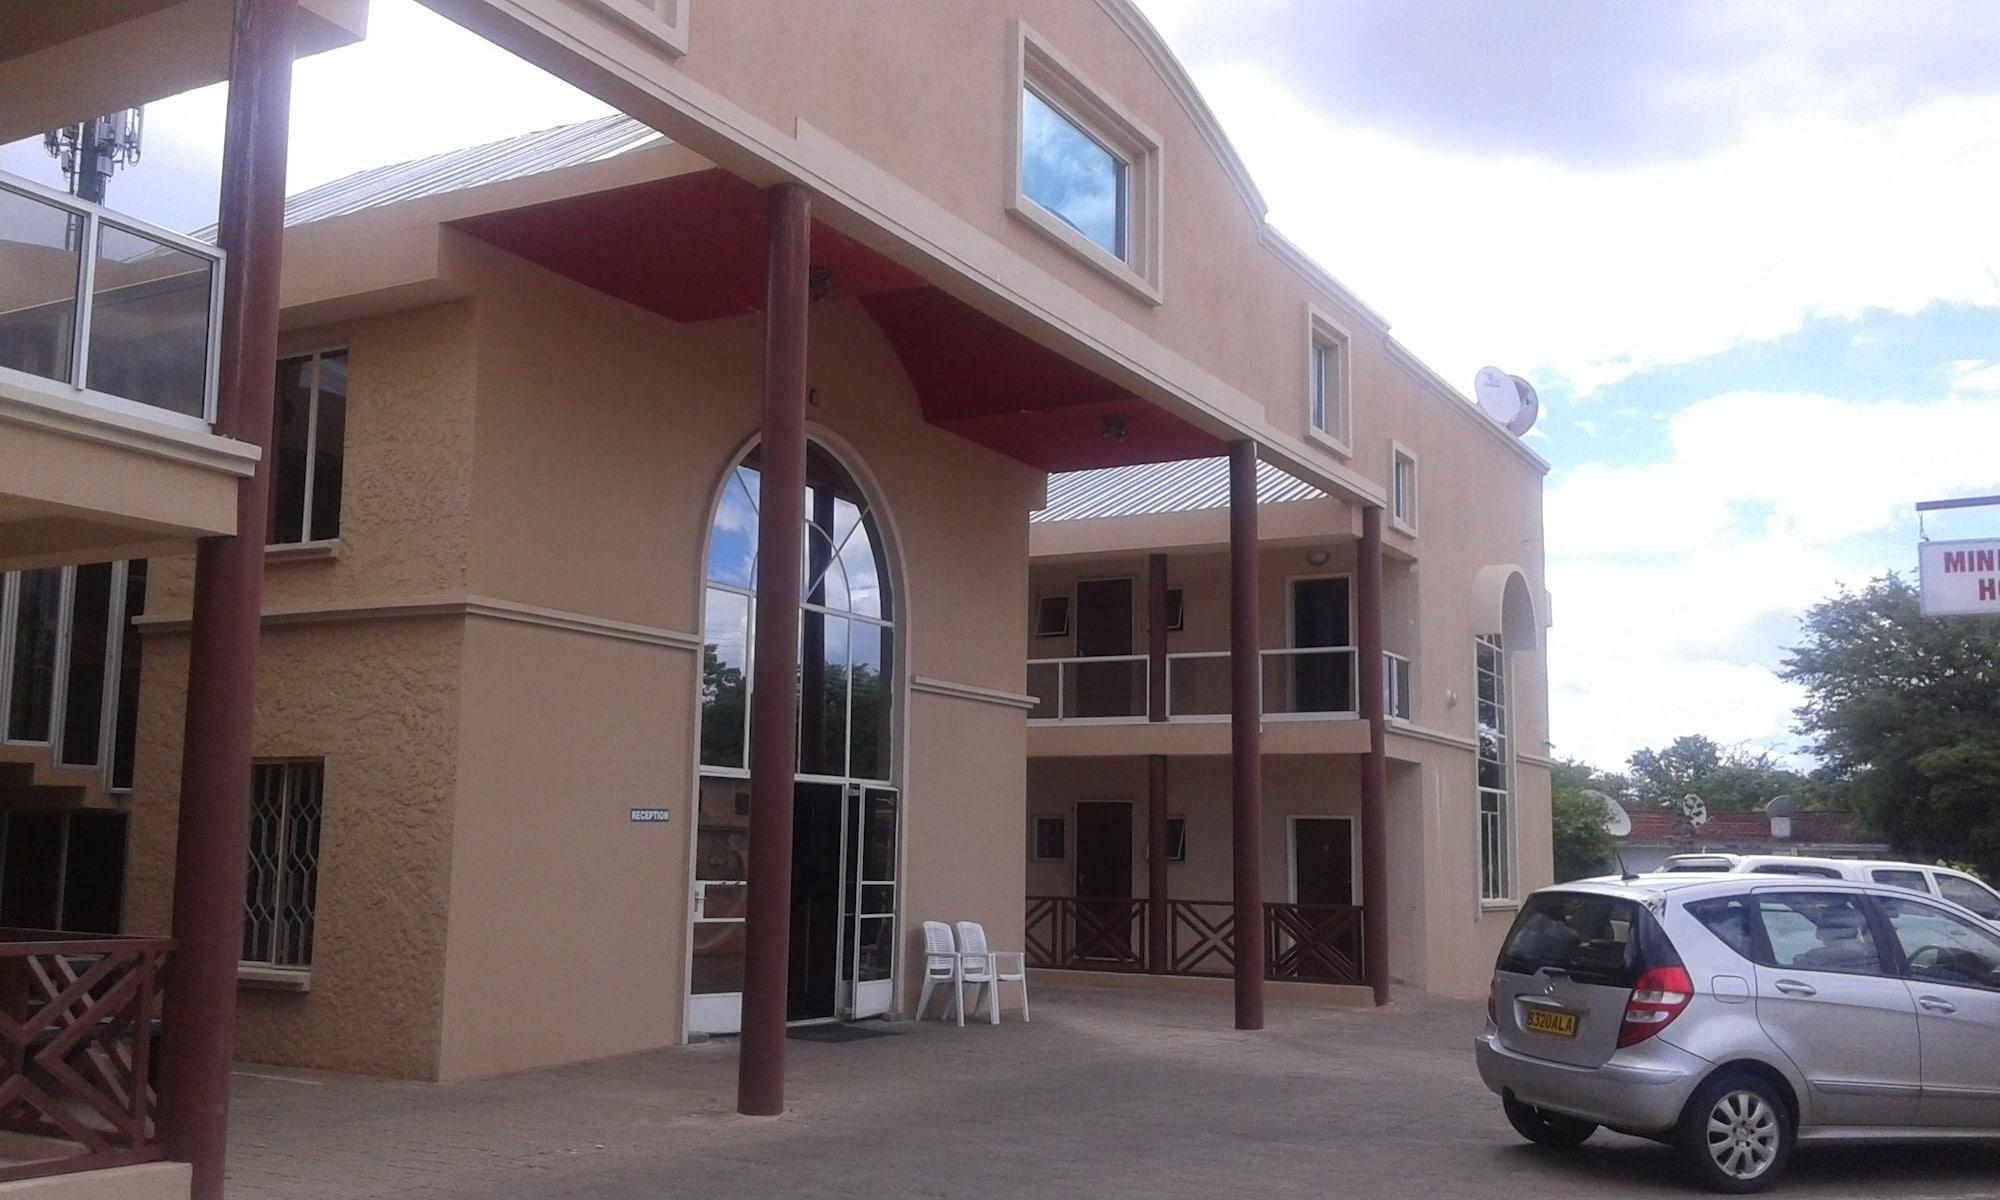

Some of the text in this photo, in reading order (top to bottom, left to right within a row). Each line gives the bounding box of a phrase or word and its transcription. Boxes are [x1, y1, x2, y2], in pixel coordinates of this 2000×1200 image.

[1944, 549, 2000, 573] MIN
[1978, 578, 2000, 601] H
[631, 810, 669, 820] RECEPTION
